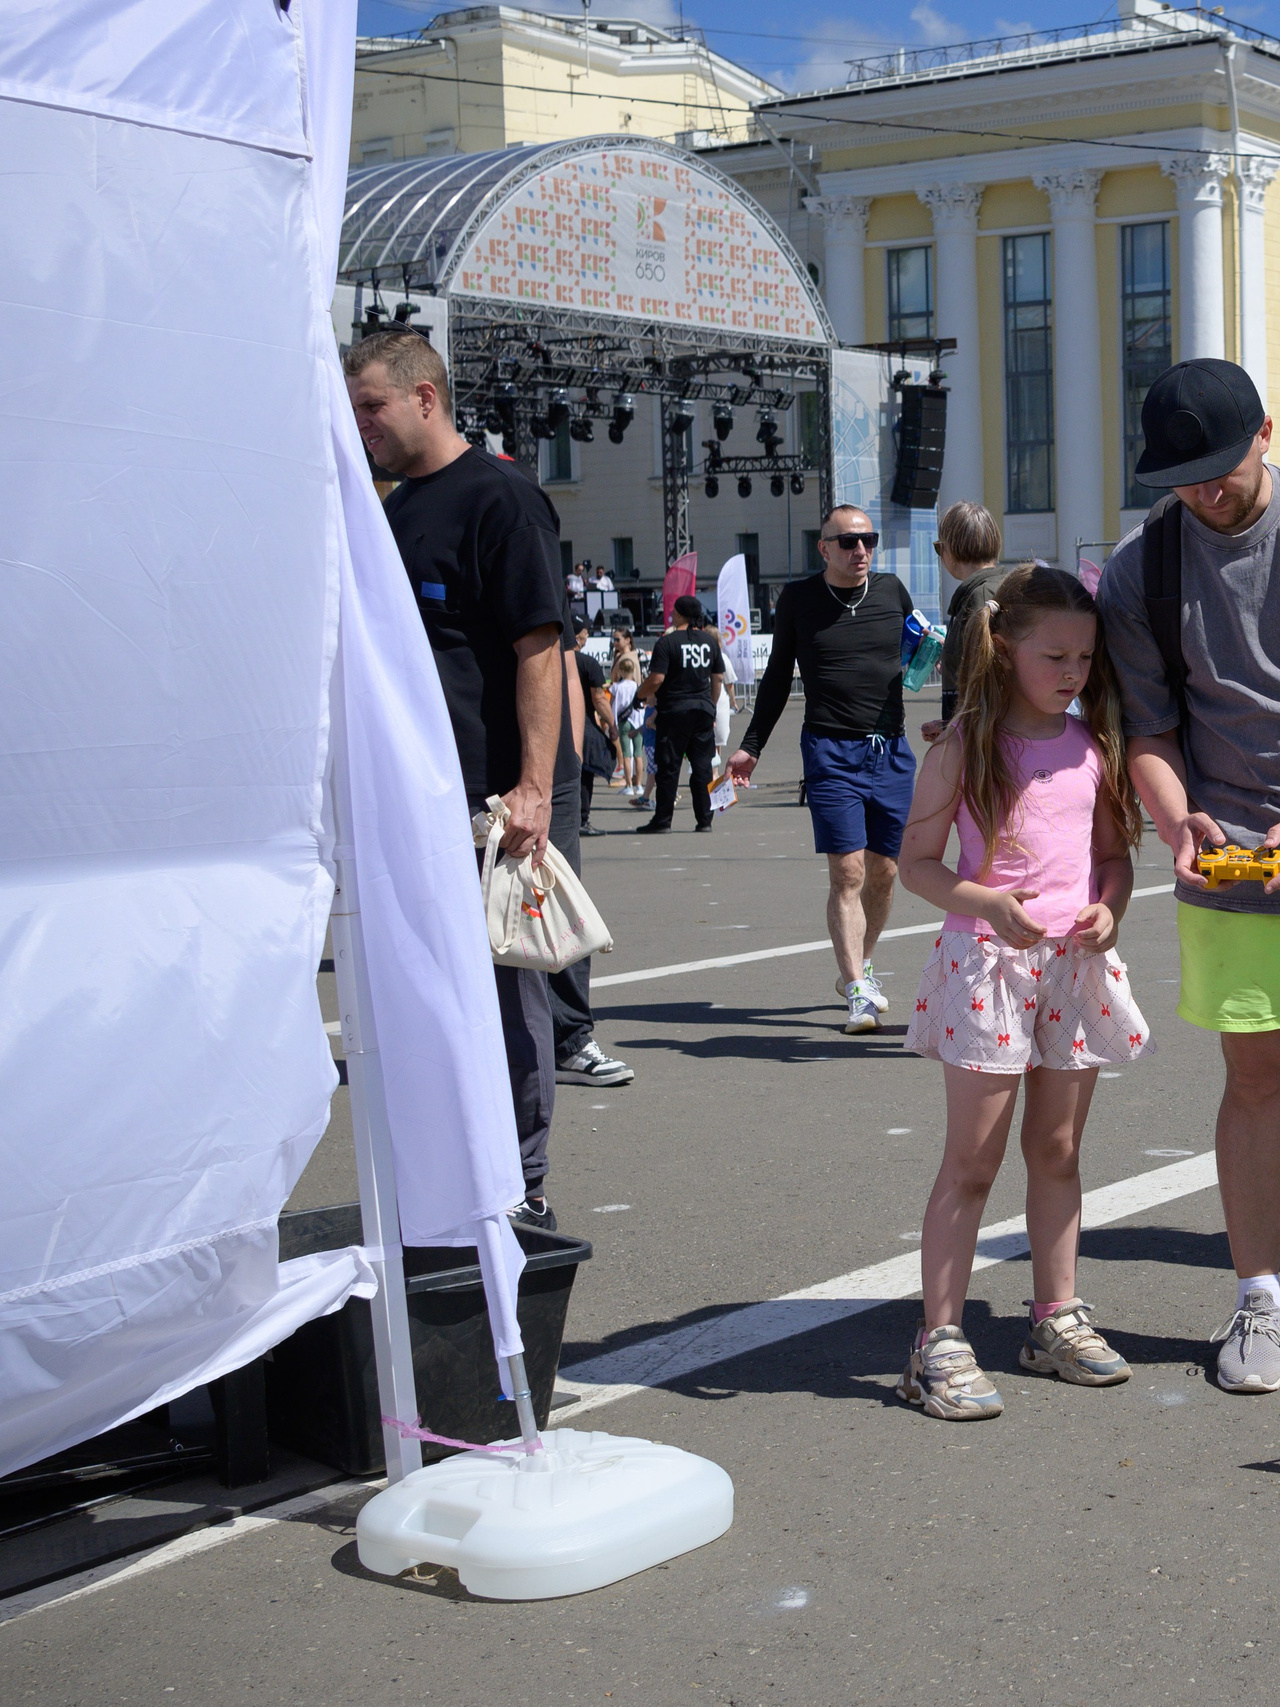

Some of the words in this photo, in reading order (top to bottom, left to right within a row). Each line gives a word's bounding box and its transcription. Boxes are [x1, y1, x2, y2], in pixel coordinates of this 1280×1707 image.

[635, 248, 666, 262] КИРОВ
[635, 262, 666, 282] 650
[680, 643, 711, 669] FSC
